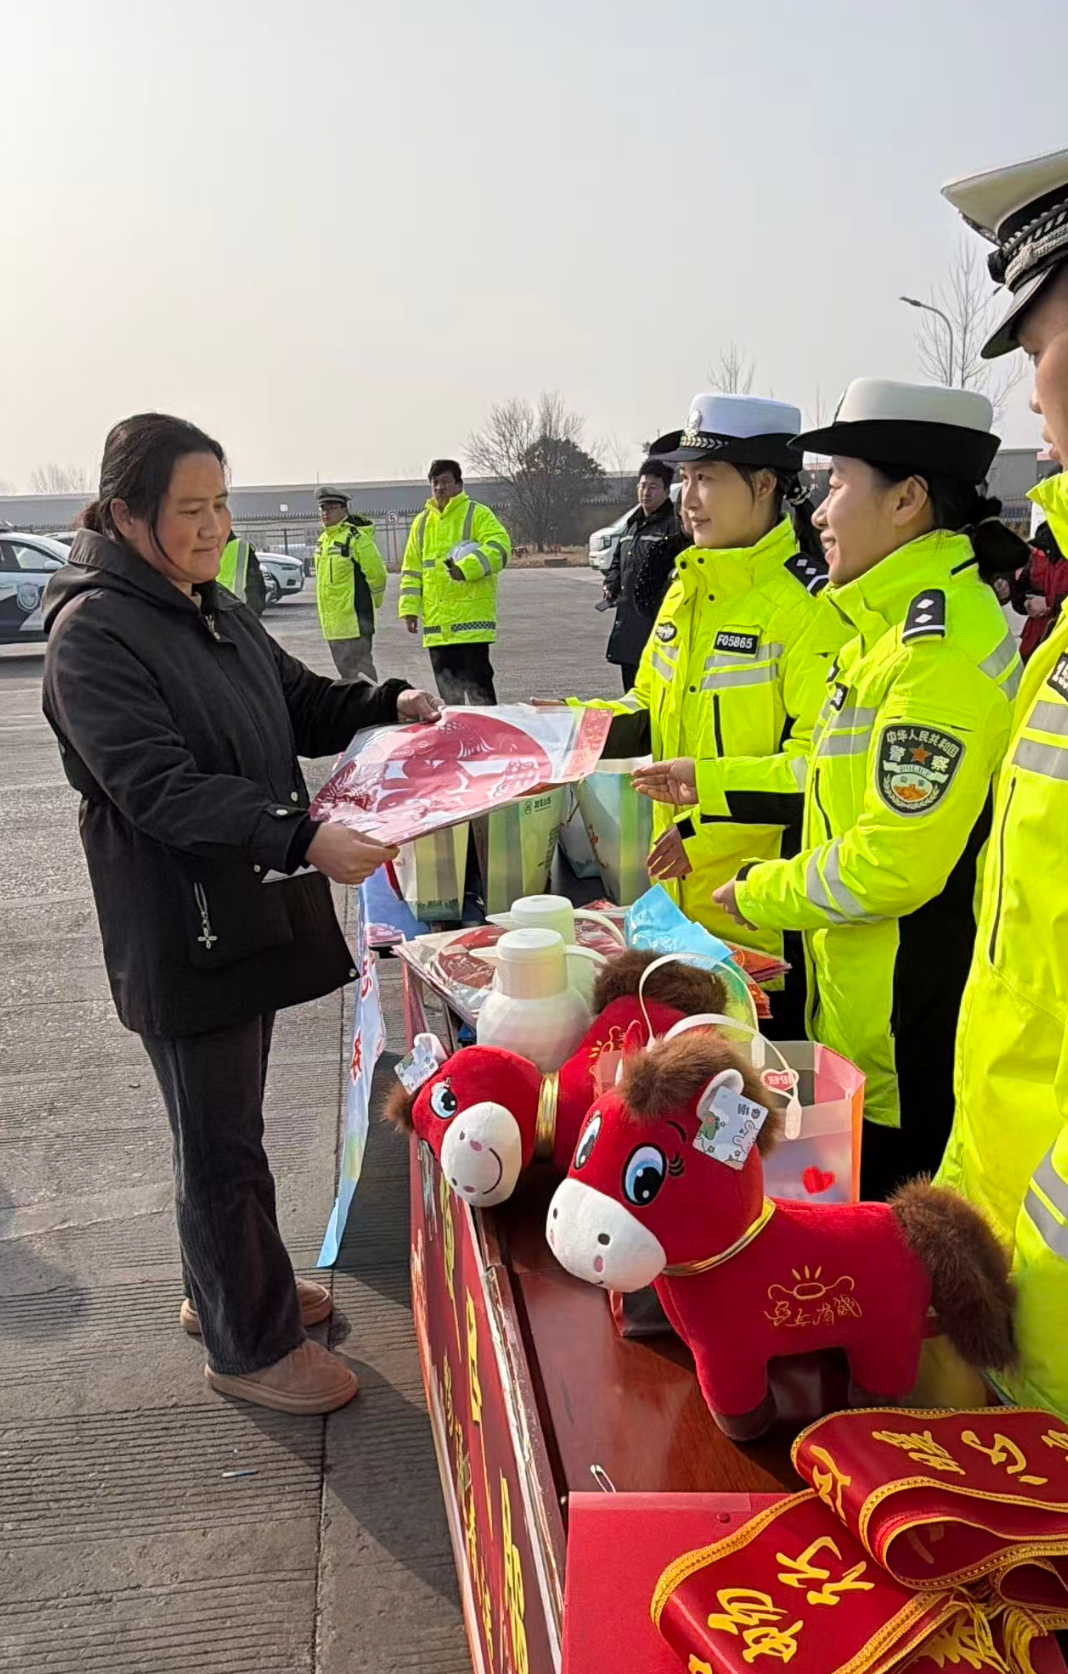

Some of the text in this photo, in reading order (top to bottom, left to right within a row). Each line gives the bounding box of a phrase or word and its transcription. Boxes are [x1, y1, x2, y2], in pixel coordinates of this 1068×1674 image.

[716, 634, 753, 649] F05865
[886, 729, 960, 758] 中华人民共和国
[889, 745, 950, 772] 警察
[899, 764, 930, 776] POLICE
[688, 1537, 875, 1674] 畅行
